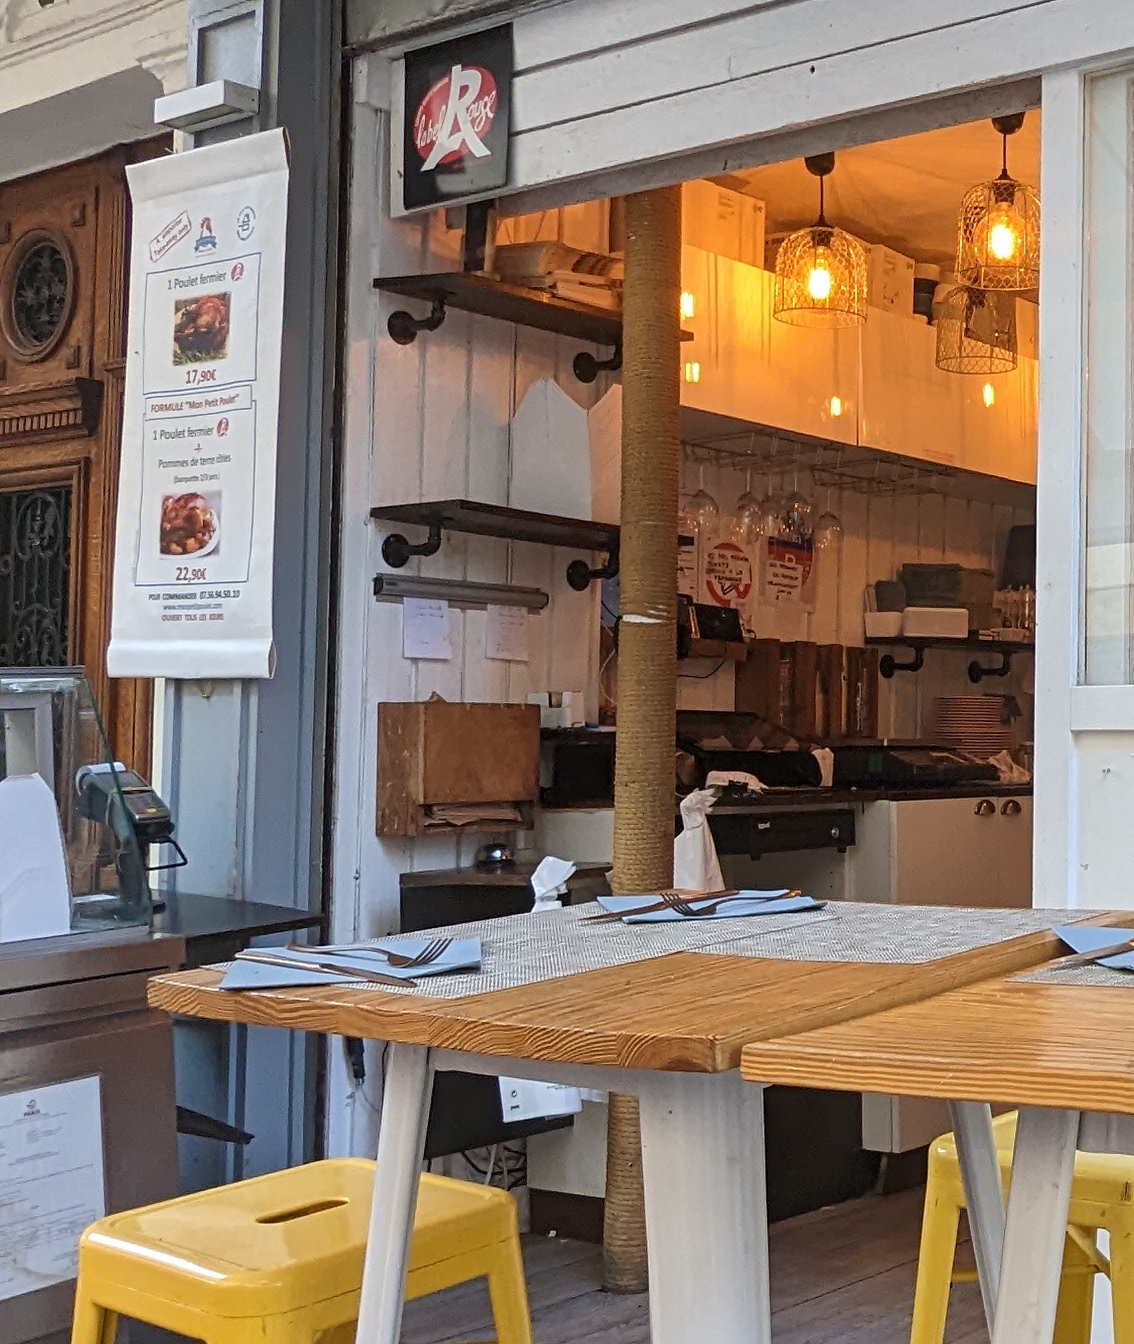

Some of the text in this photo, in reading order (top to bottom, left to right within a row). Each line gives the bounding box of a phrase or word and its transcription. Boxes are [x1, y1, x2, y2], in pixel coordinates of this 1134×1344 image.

[174, 275, 199, 289] Poulet
[200, 270, 227, 285] fermier
[185, 369, 217, 385] 17,90€
[151, 401, 184, 413] FORMULE
[159, 427, 186, 439] Poulet
[187, 425, 215, 438] fermier
[175, 566, 207, 582] 22,90€
